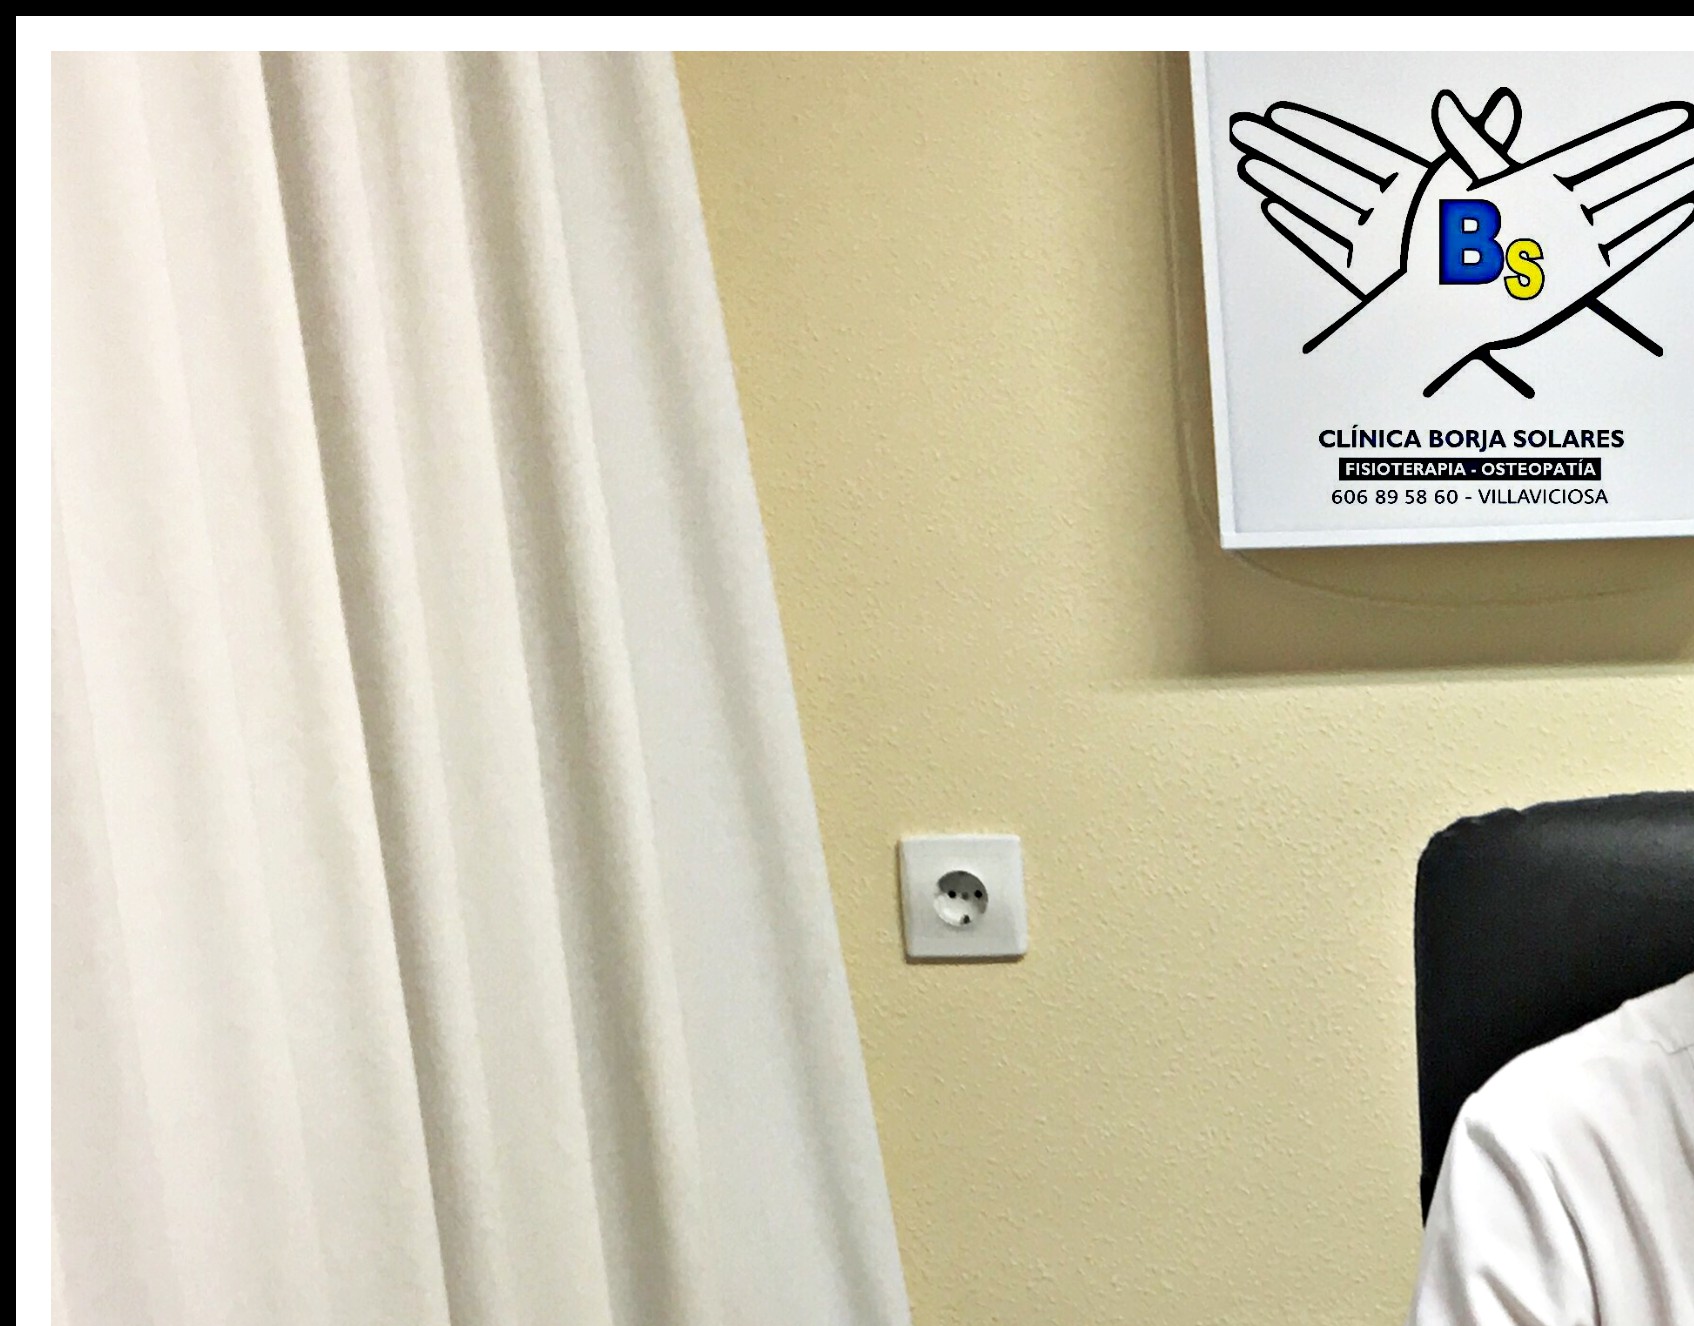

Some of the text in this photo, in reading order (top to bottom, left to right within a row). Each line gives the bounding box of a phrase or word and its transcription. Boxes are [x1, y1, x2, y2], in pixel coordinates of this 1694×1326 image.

[1318, 424, 1625, 452] CLÍNICA BORJA SOLARES
[1345, 462, 1467, 476] FISIOTERAPIA
[1481, 459, 1597, 476] OSTEOPATÍA
[1331, 489, 1368, 504] 606
[1376, 489, 1399, 504] 89
[1405, 489, 1427, 504] 58
[1434, 489, 1459, 504] 60
[1478, 489, 1609, 504] VILLAVICIOSA
